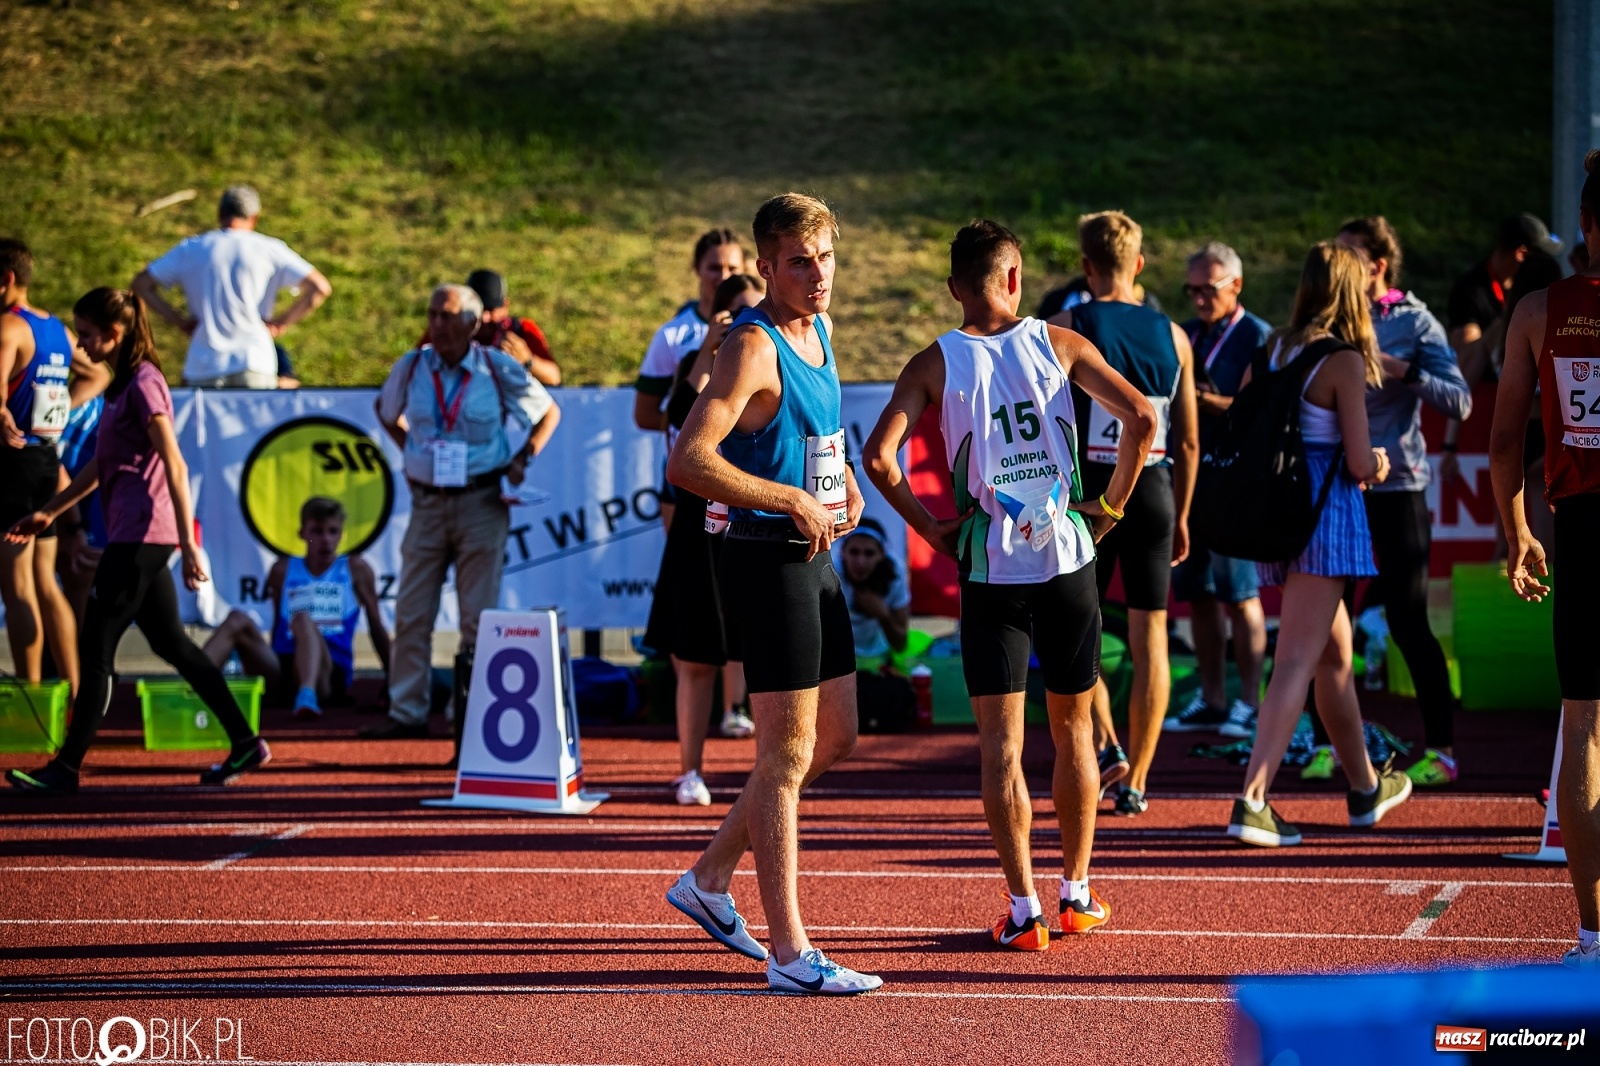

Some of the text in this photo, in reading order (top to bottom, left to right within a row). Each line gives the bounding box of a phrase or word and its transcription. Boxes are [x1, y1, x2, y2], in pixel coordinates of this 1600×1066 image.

[991, 400, 1041, 445] 15
[1001, 450, 1048, 468] OLIMPIA
[542, 505, 588, 549] W
[482, 647, 540, 763] 8
